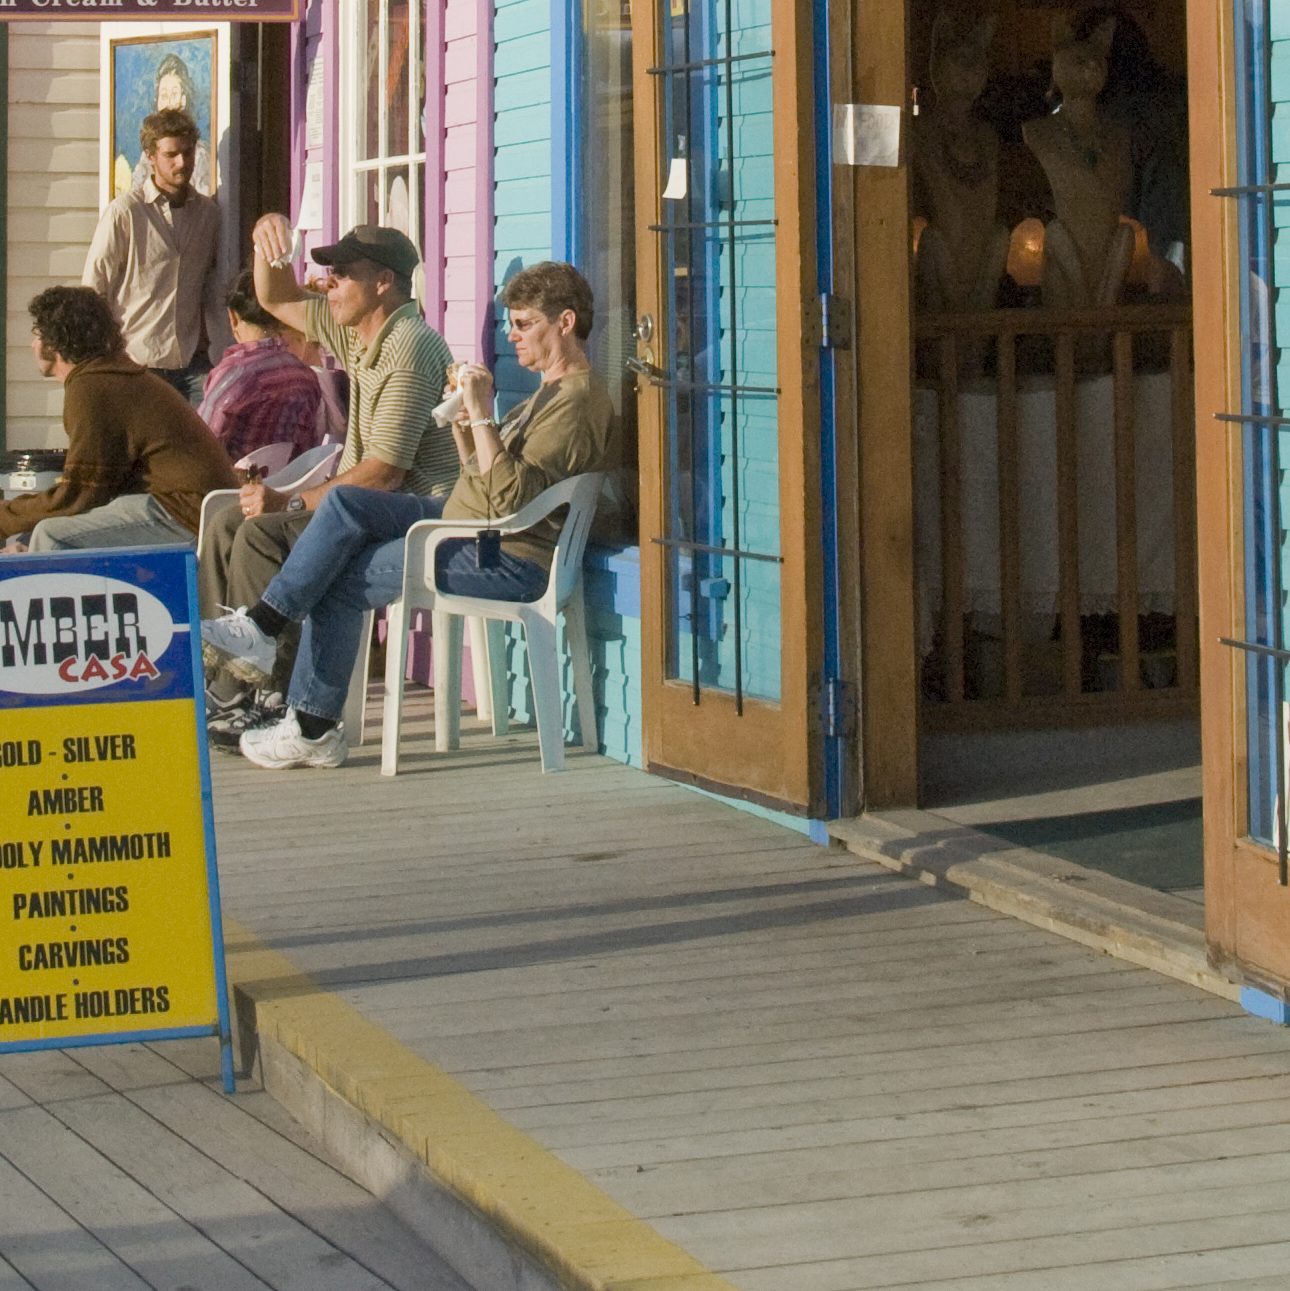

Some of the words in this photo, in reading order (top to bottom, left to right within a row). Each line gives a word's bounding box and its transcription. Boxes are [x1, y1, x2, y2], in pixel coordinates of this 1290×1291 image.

[58, 650, 161, 683] CASA
[63, 733, 137, 764] SILVER
[27, 786, 105, 816] AMBER
[51, 832, 171, 866] MAMMOTH
[13, 886, 129, 920] PAINTINGS
[18, 937, 130, 971] CARVINGS
[74, 985, 171, 1019] HOLDERS
